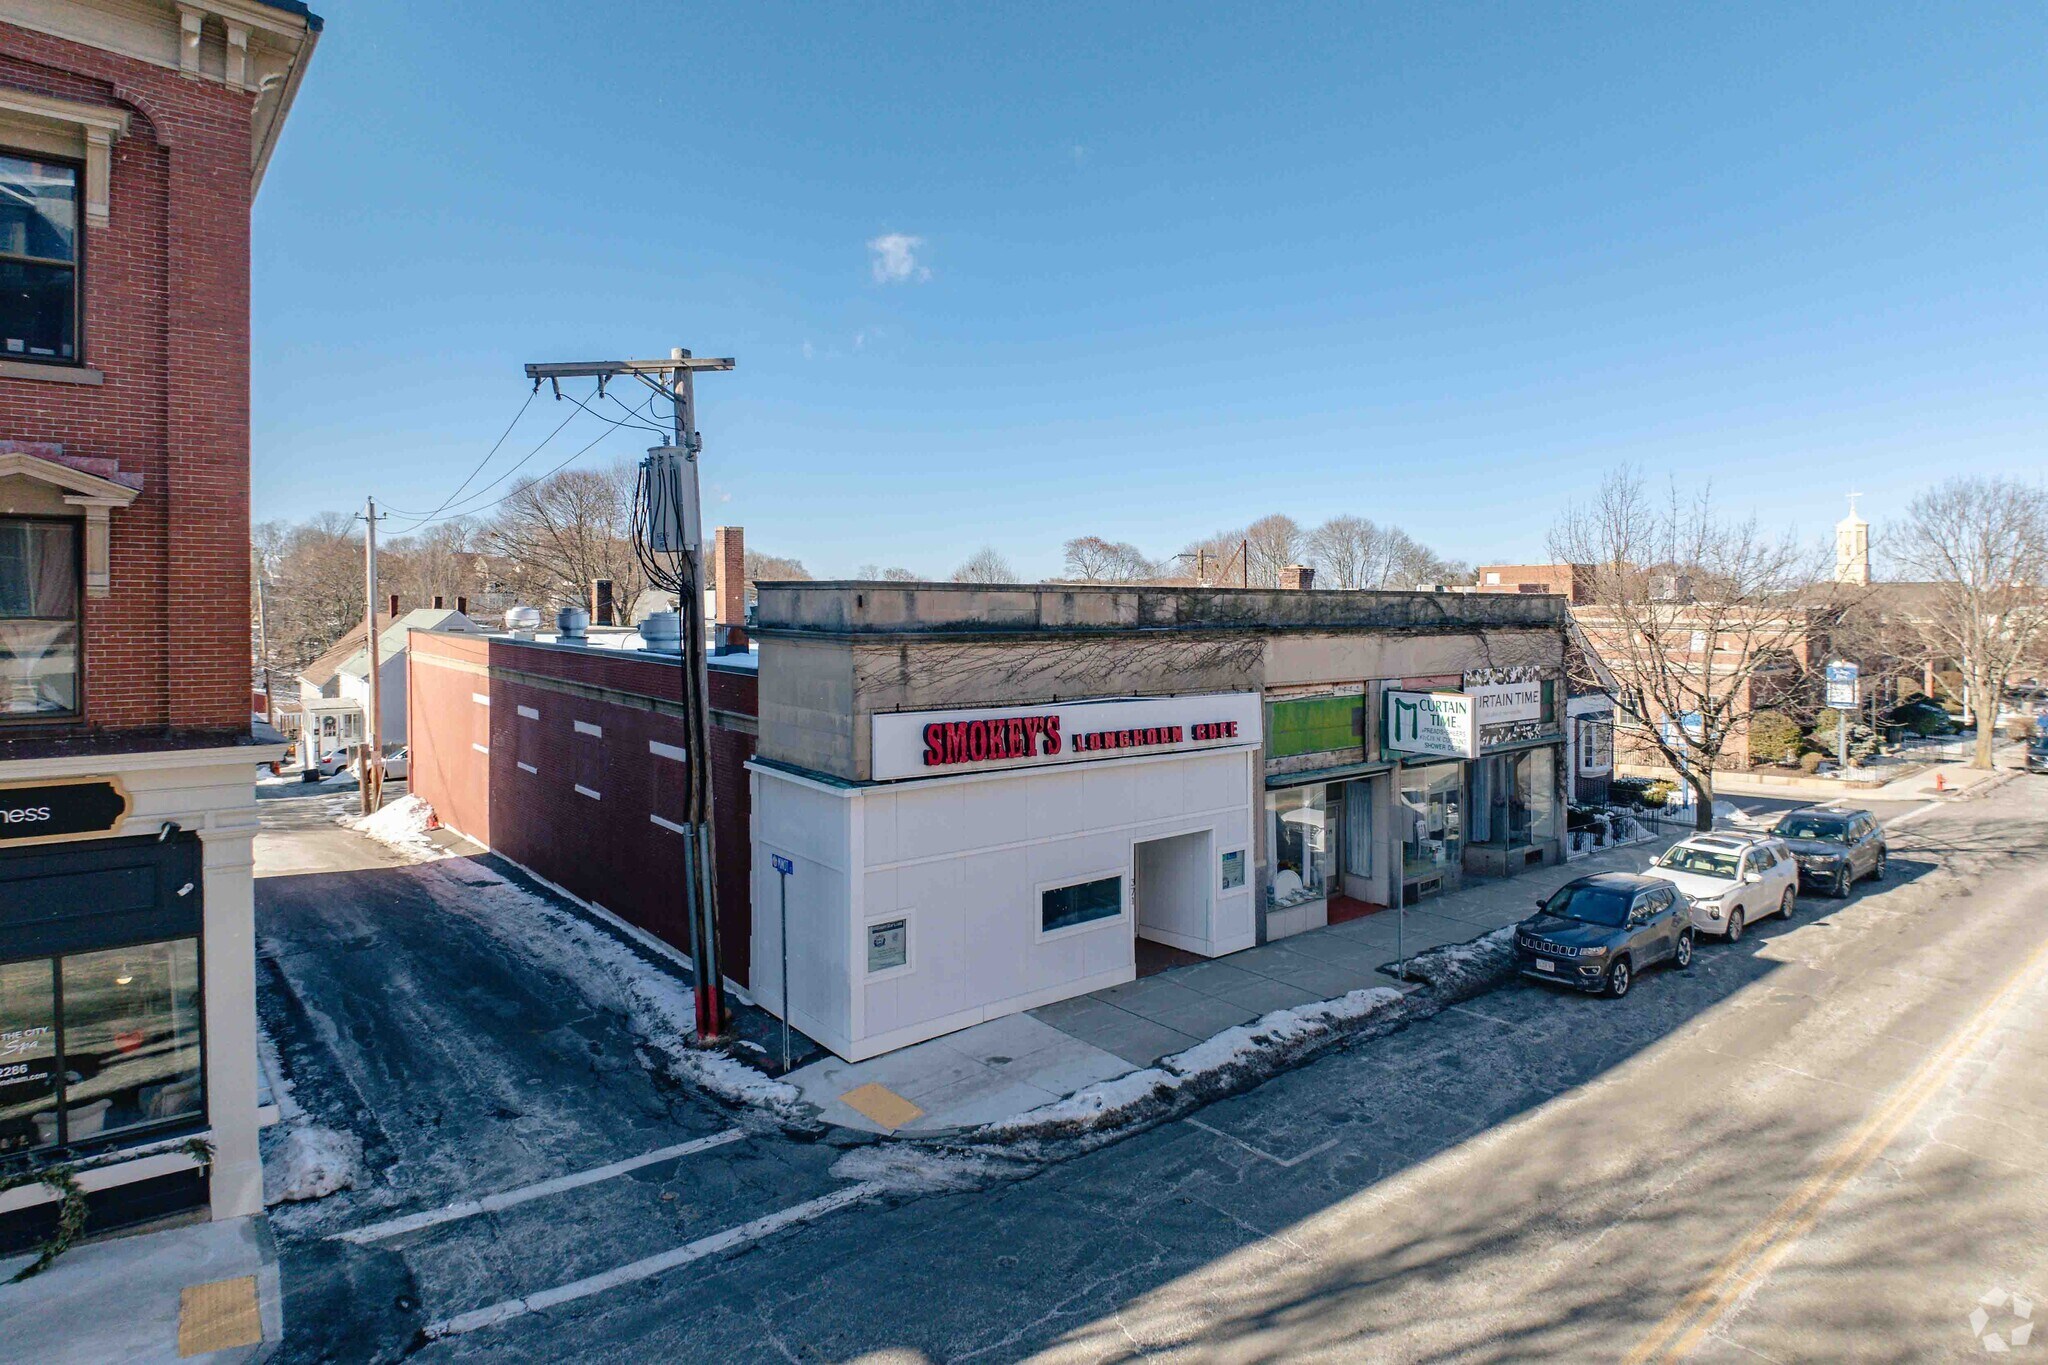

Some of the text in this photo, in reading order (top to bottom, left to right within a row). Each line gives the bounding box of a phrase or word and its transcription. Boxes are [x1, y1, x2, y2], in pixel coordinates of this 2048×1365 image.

[1515, 691, 1539, 705] TIME
[1419, 699, 1467, 714] CURTAIN
[1430, 713, 1457, 728] TIME
[923, 715, 1238, 766] SMOKEY'S LONGHORN CAFE
[1424, 742, 1446, 750] SHOWER
[1, 1026, 50, 1041] THE CITY
[0, 1038, 39, 1056] Spa
